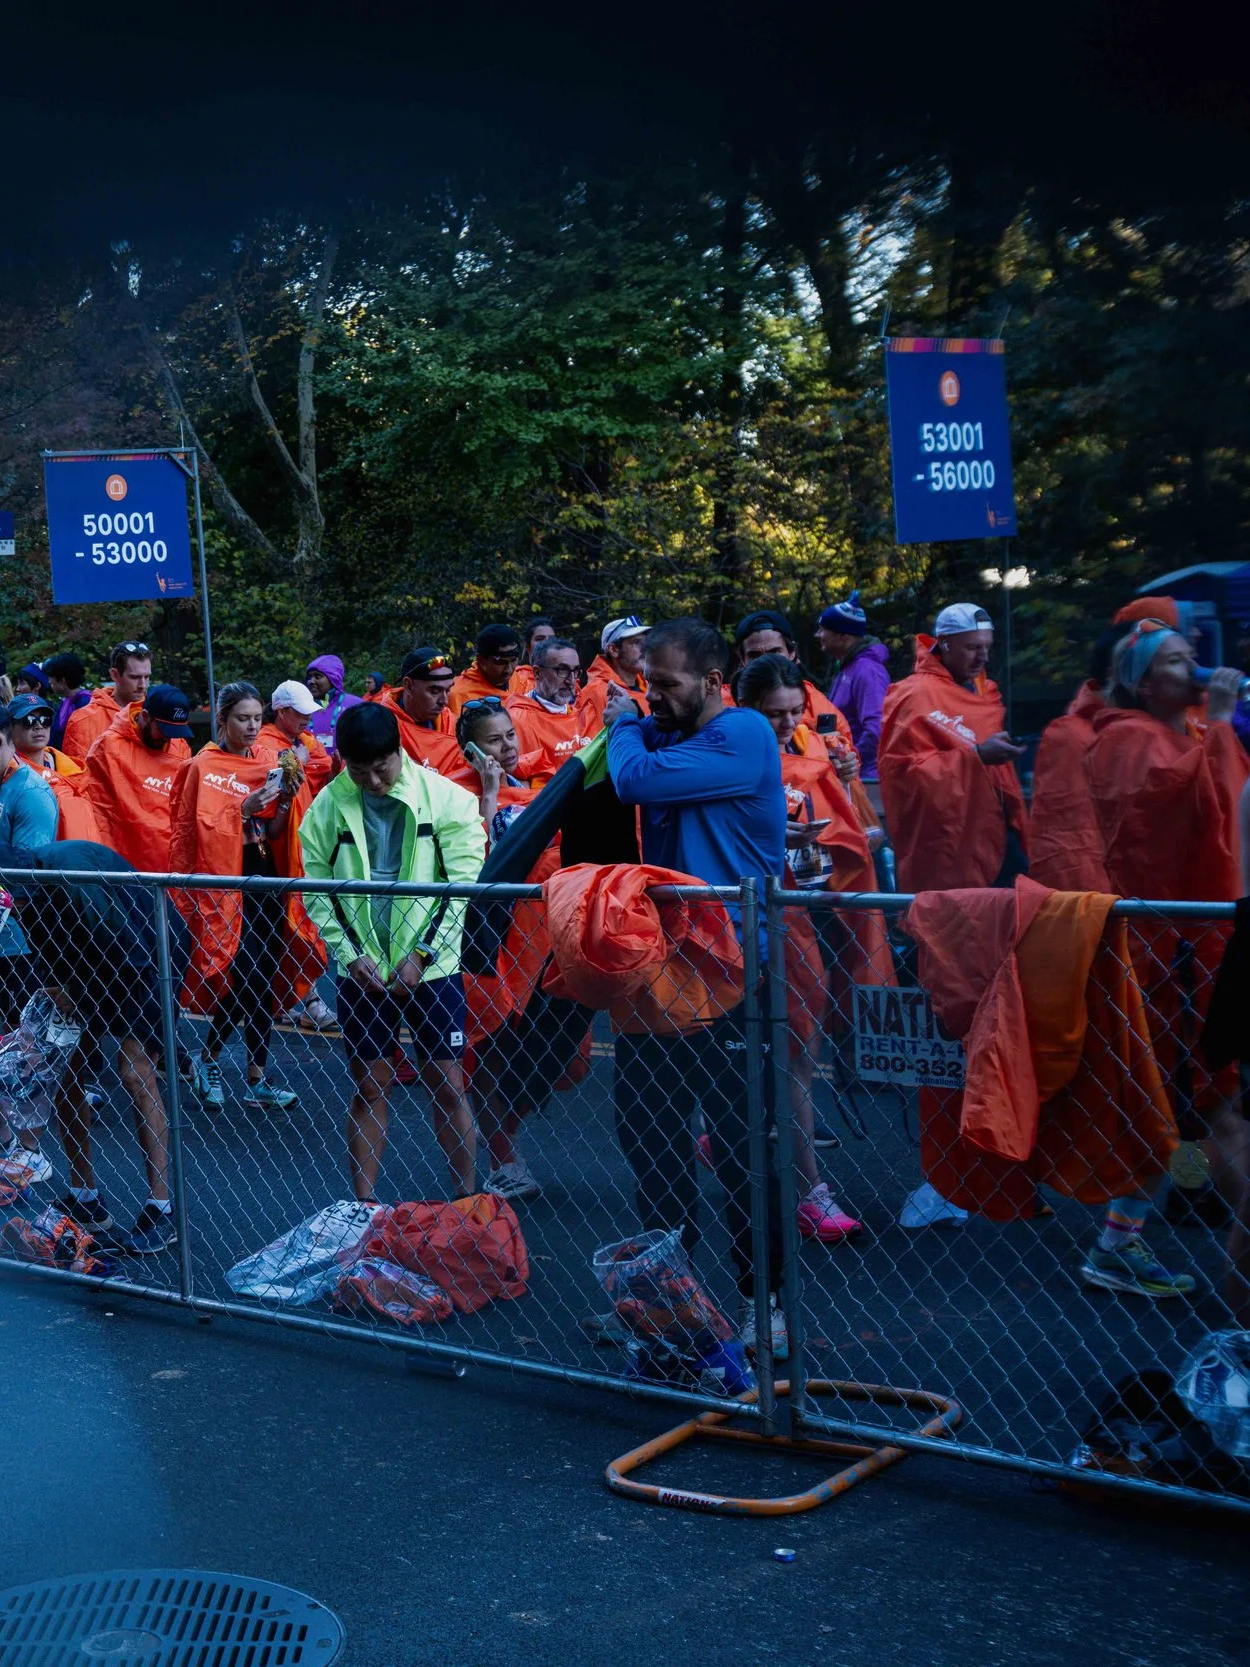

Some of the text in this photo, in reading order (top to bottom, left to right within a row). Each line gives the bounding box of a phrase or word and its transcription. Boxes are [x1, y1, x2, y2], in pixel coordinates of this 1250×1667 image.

[922, 421, 984, 453] 53001
[930, 459, 996, 491] 56000
[83, 511, 155, 536] 50001
[92, 540, 168, 565] 53000
